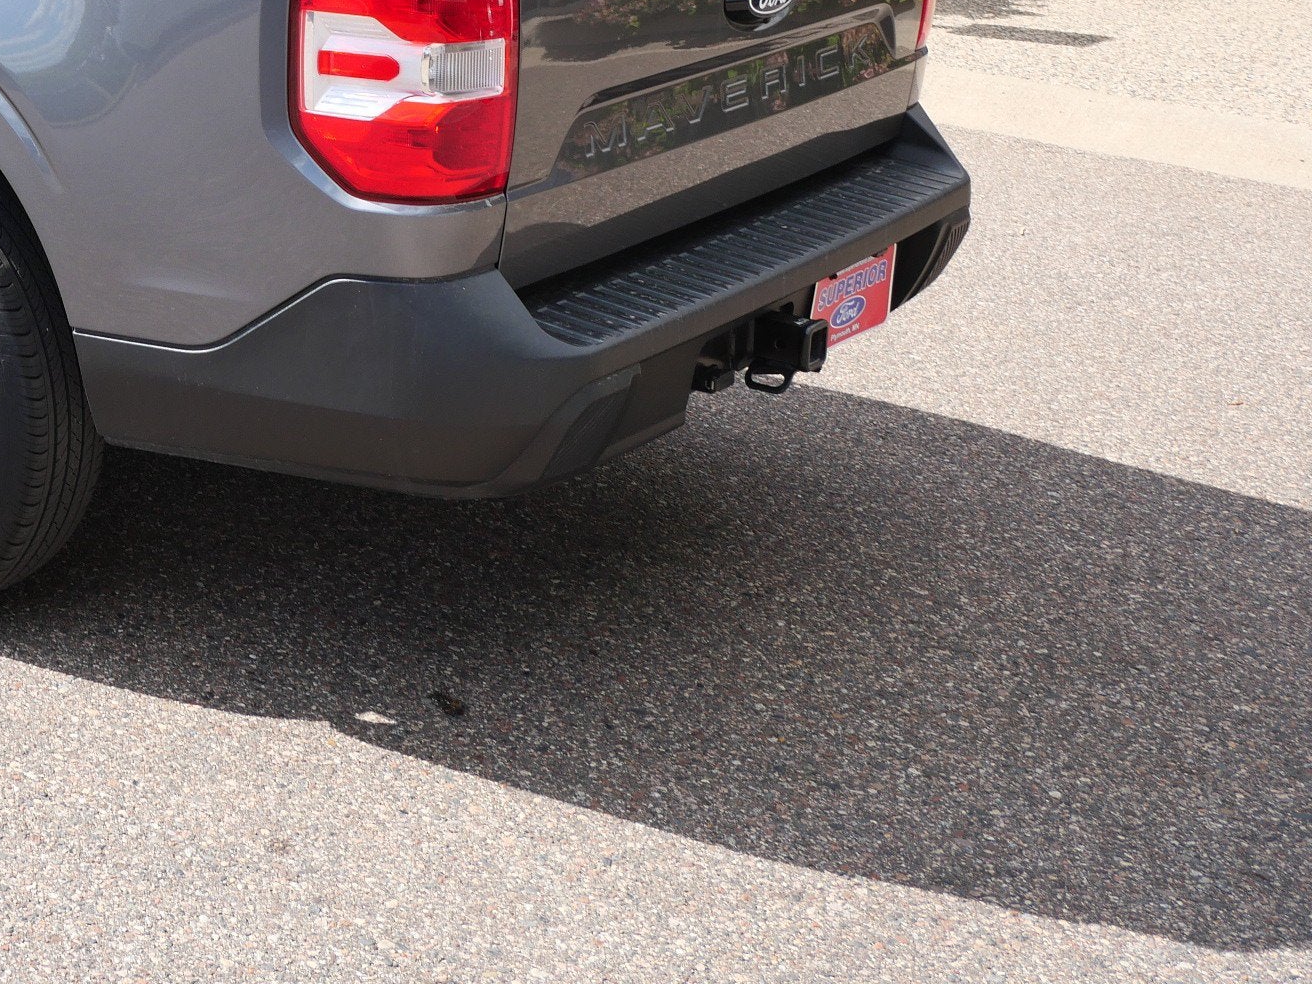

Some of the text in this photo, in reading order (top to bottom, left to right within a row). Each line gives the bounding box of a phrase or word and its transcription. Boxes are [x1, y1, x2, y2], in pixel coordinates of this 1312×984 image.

[584, 35, 874, 158] MAVERICK
[816, 258, 888, 312] SUPERIOR
[835, 299, 861, 324] Ford
